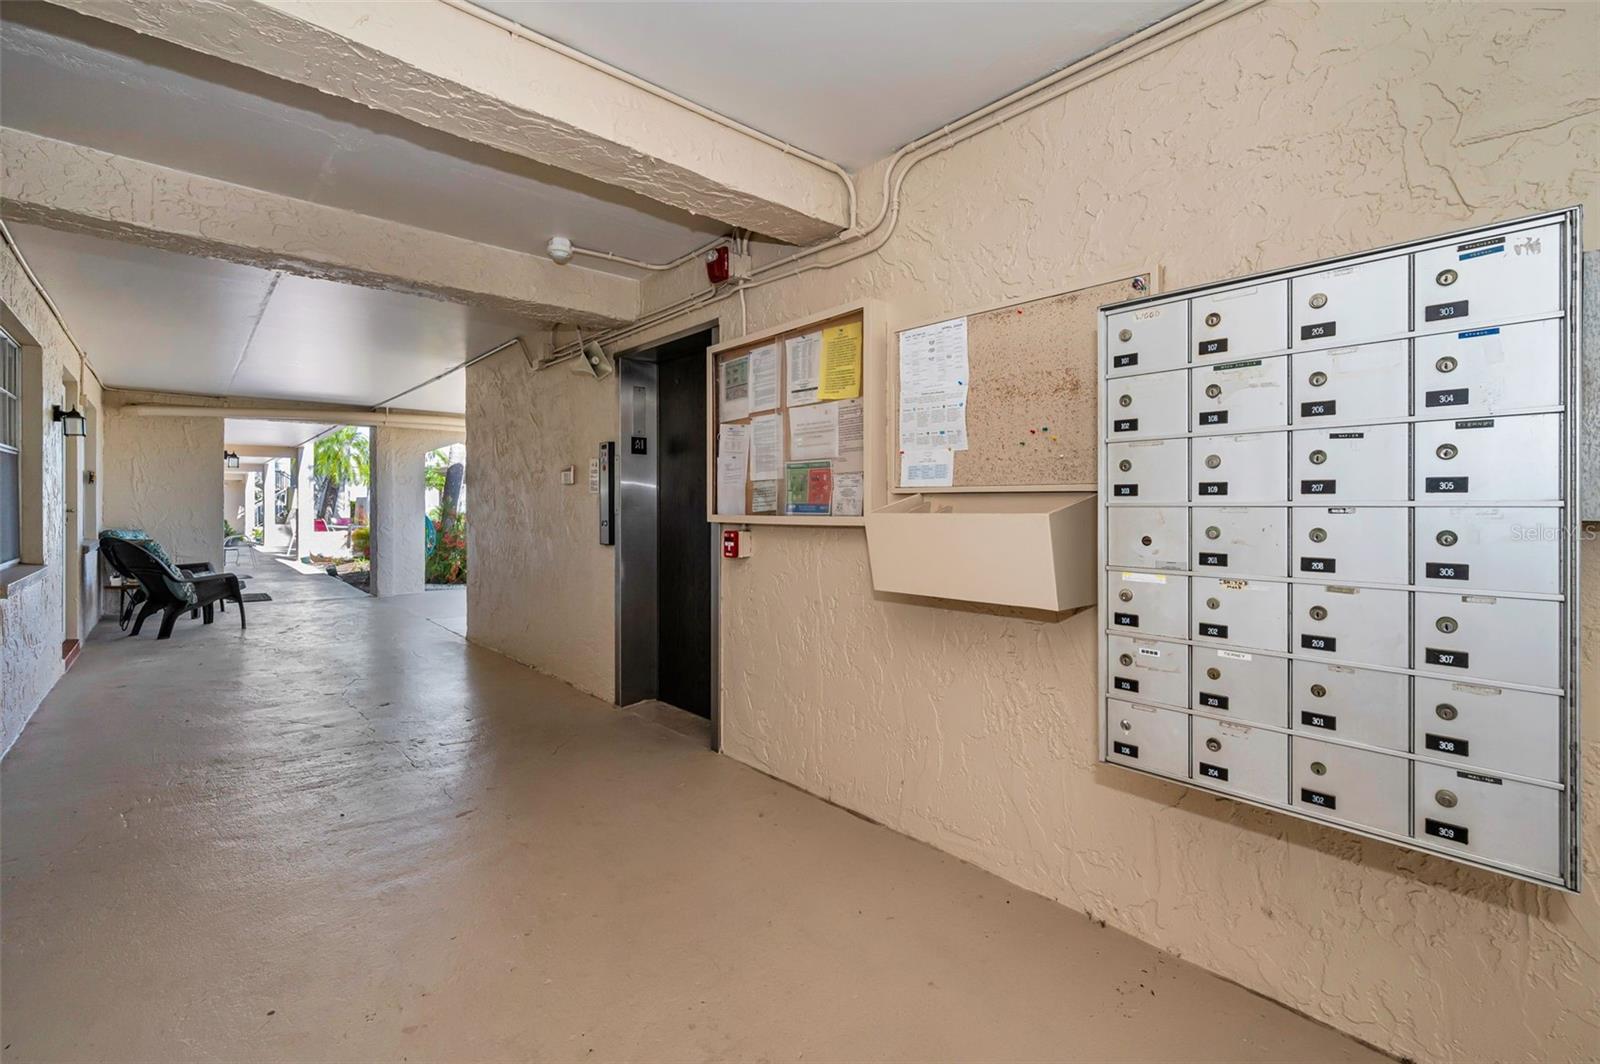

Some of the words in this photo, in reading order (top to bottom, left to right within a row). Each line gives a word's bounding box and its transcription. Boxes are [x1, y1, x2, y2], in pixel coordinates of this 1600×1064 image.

[1439, 306, 1454, 316] 303
[1311, 327, 1324, 336] 205
[1439, 394, 1454, 403] 304
[1311, 406, 1324, 414] 206
[1311, 484, 1324, 492] 207
[1439, 482, 1454, 490] 305
[1311, 562, 1324, 570] 208
[1439, 568, 1454, 576] 306
[1311, 640, 1324, 648] 209
[1439, 654, 1454, 664] 307
[1311, 718, 1324, 726] 301
[1439, 740, 1454, 751] 308
[1207, 768, 1218, 777] 204
[1311, 795, 1324, 804] 302
[1439, 826, 1454, 838] 309
